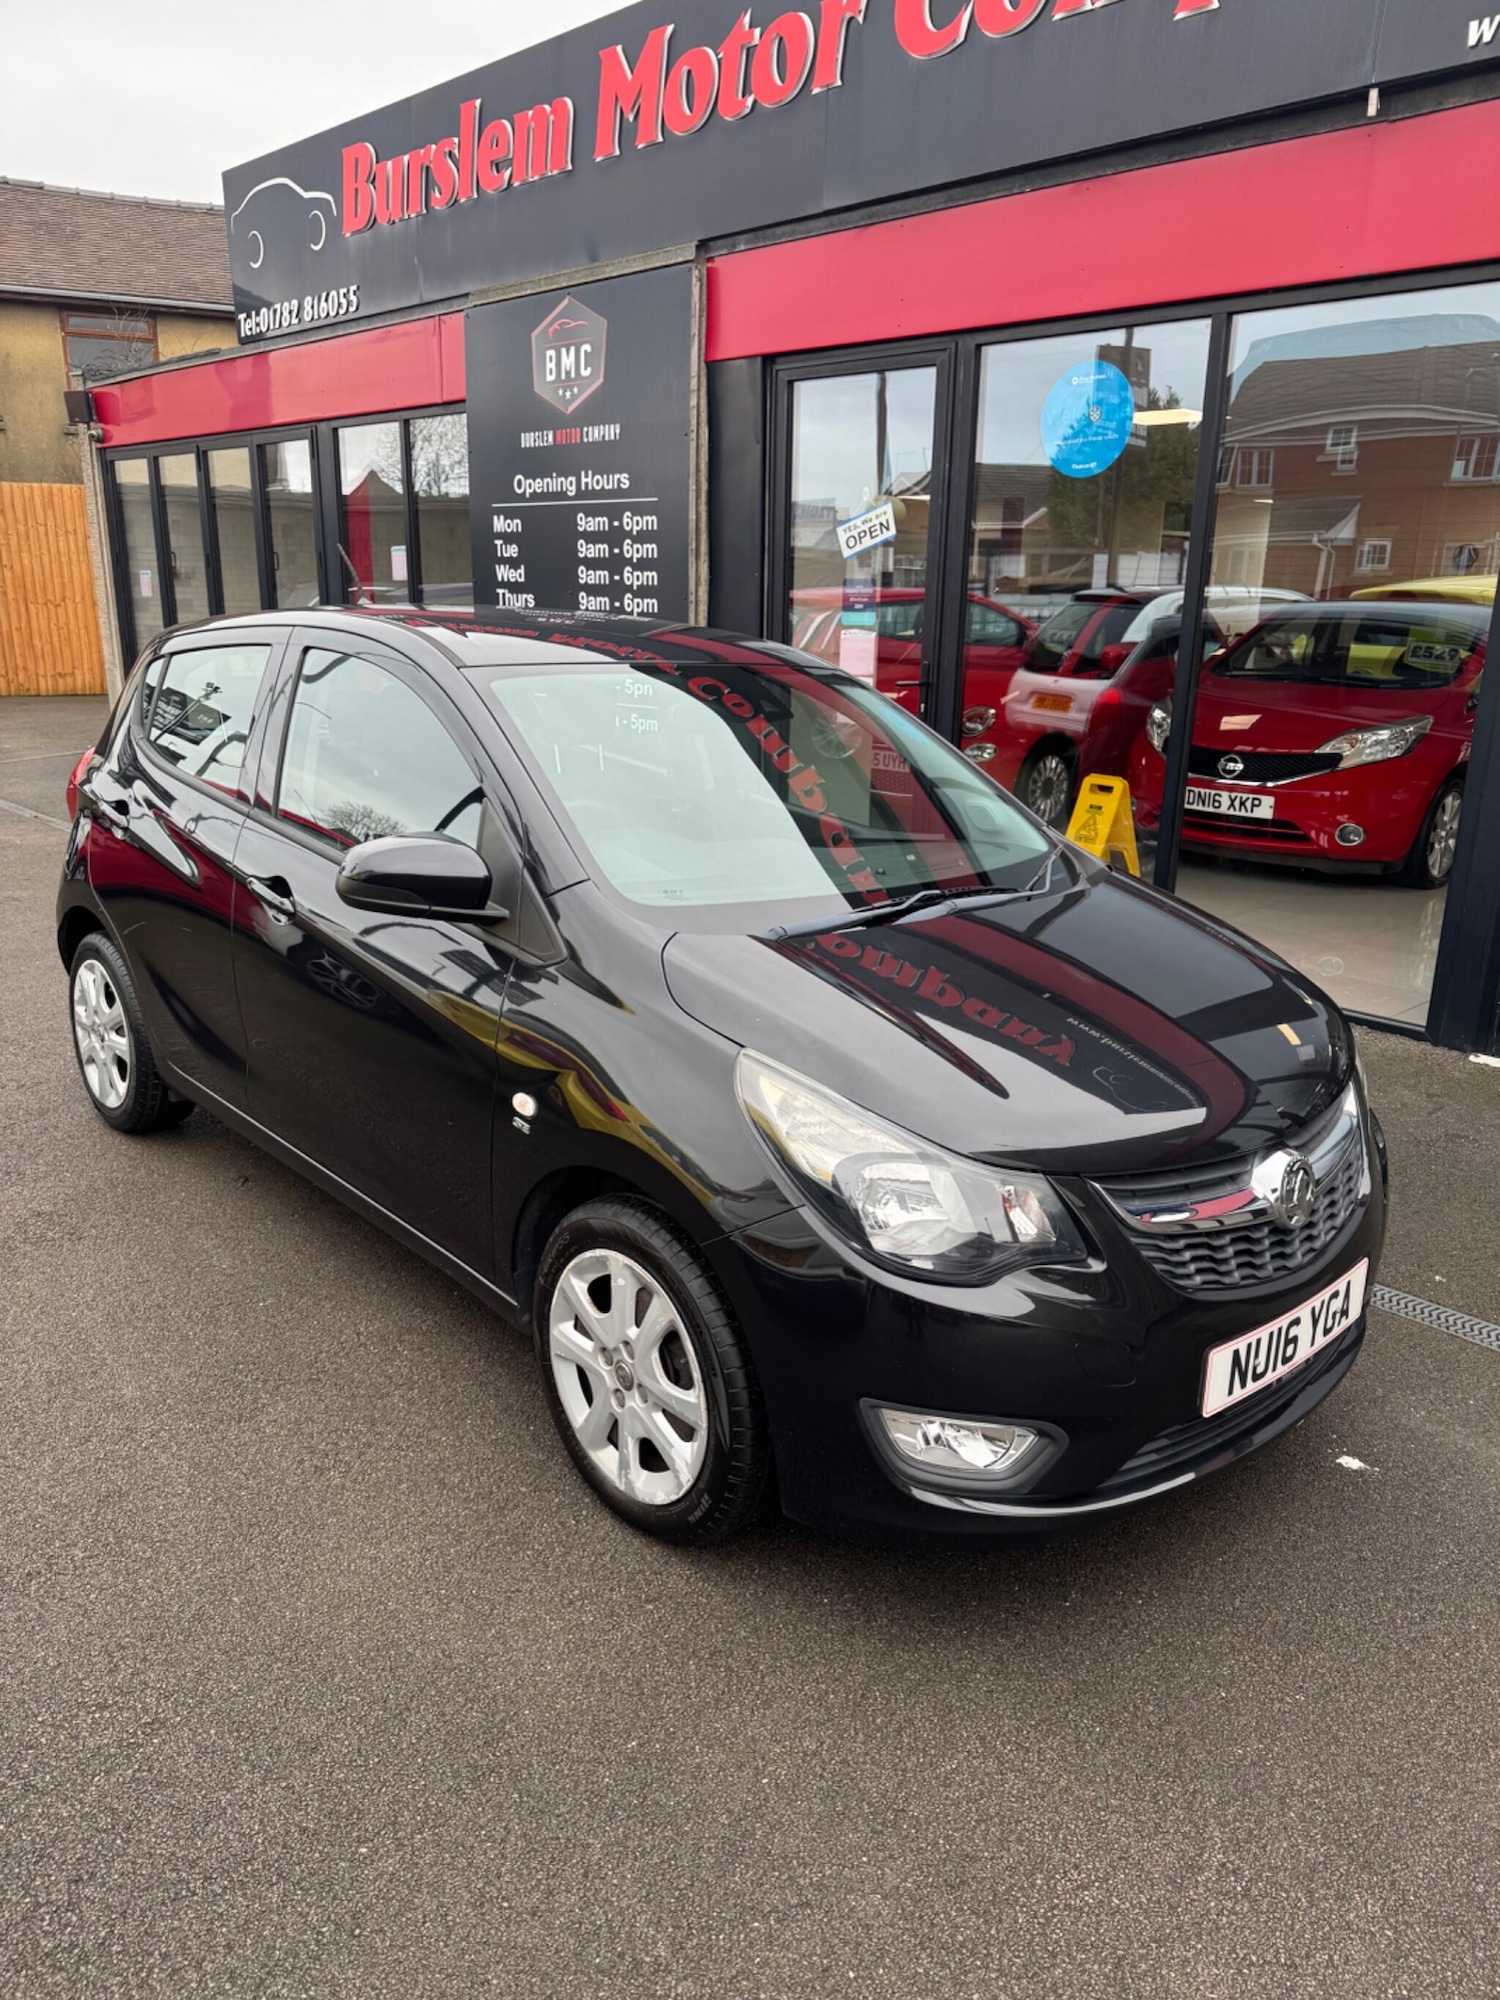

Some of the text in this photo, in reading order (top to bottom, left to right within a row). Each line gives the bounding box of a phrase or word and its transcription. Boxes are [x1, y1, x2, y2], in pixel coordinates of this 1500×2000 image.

[341, 97, 575, 236] Burslem
[593, 0, 867, 162] Motor
[238, 284, 359, 338] Tel:01782 816055
[545, 344, 592, 382] BMC
[521, 423, 620, 448] BURSLEM MOTOR COMPANY
[513, 470, 630, 497] Opening Hours
[493, 515, 522, 533] Mon
[577, 512, 609, 532] 9am
[622, 511, 658, 535] 6pm
[845, 518, 891, 550] OPEN
[494, 540, 519, 557] Tue
[577, 539, 609, 558] 9am
[623, 539, 658, 563] 6pm
[495, 564, 525, 582] Wed
[578, 565, 610, 585] 9am
[623, 566, 658, 590] 6pm
[496, 588, 536, 608] Thurs
[578, 591, 610, 611] 9am
[624, 593, 658, 617] 6pm
[630, 714, 658, 734] 5pm
[1186, 788, 1262, 814] DN16 XKP
[1228, 1280, 1352, 1397] NU16 YGA
